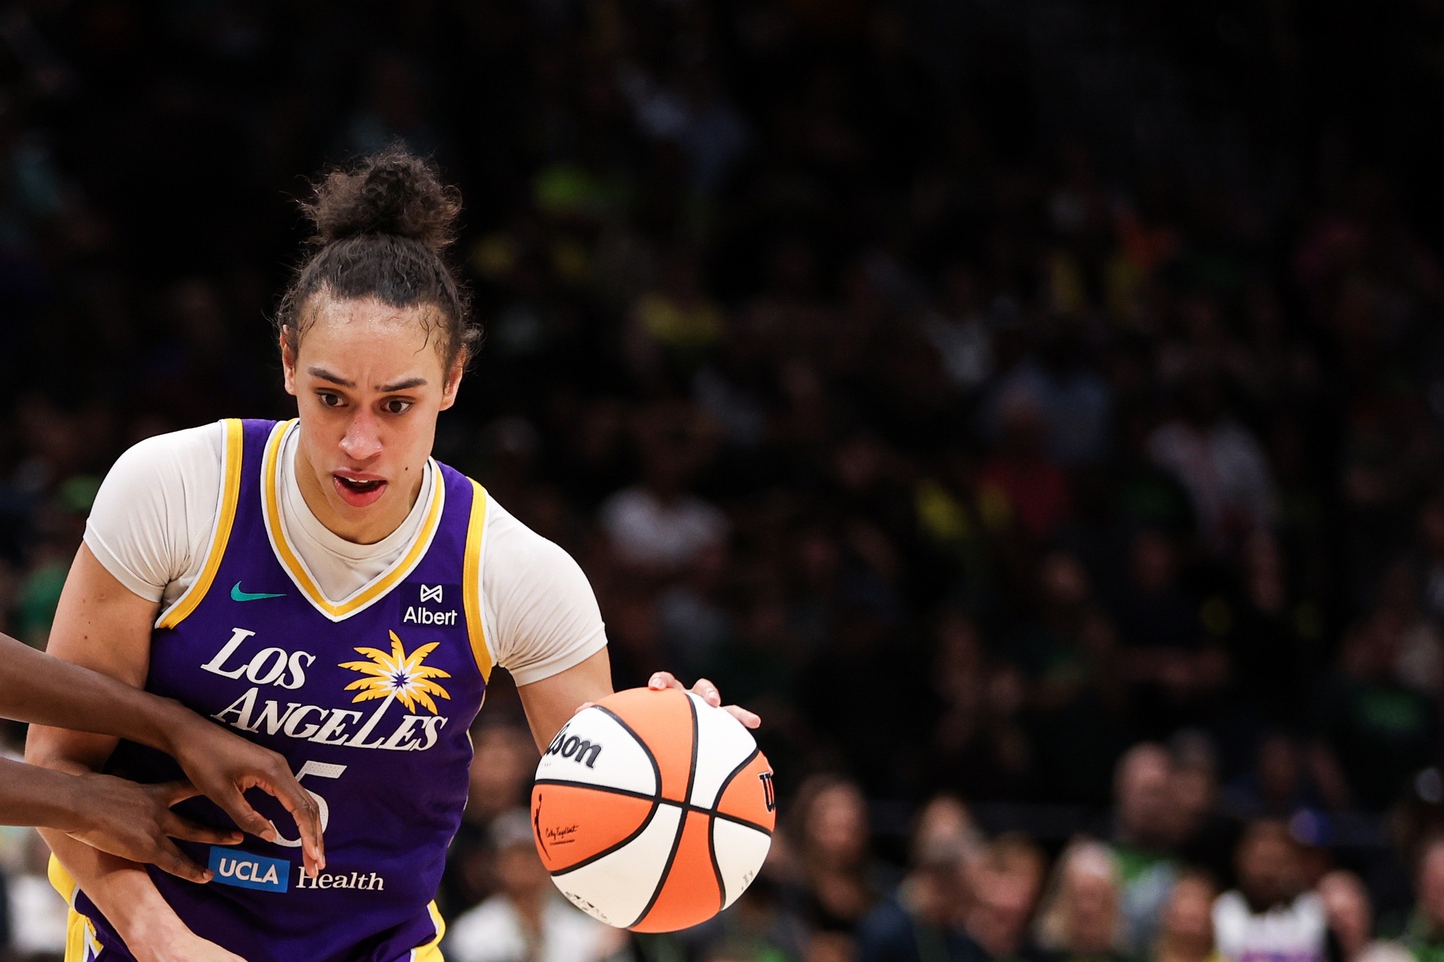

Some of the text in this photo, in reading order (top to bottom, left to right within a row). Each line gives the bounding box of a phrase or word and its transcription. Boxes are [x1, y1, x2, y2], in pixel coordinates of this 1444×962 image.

[403, 606, 458, 626] Albert
[200, 627, 316, 690] LOS
[209, 687, 449, 752] ANGELES
[218, 857, 385, 891] UCLA Health
